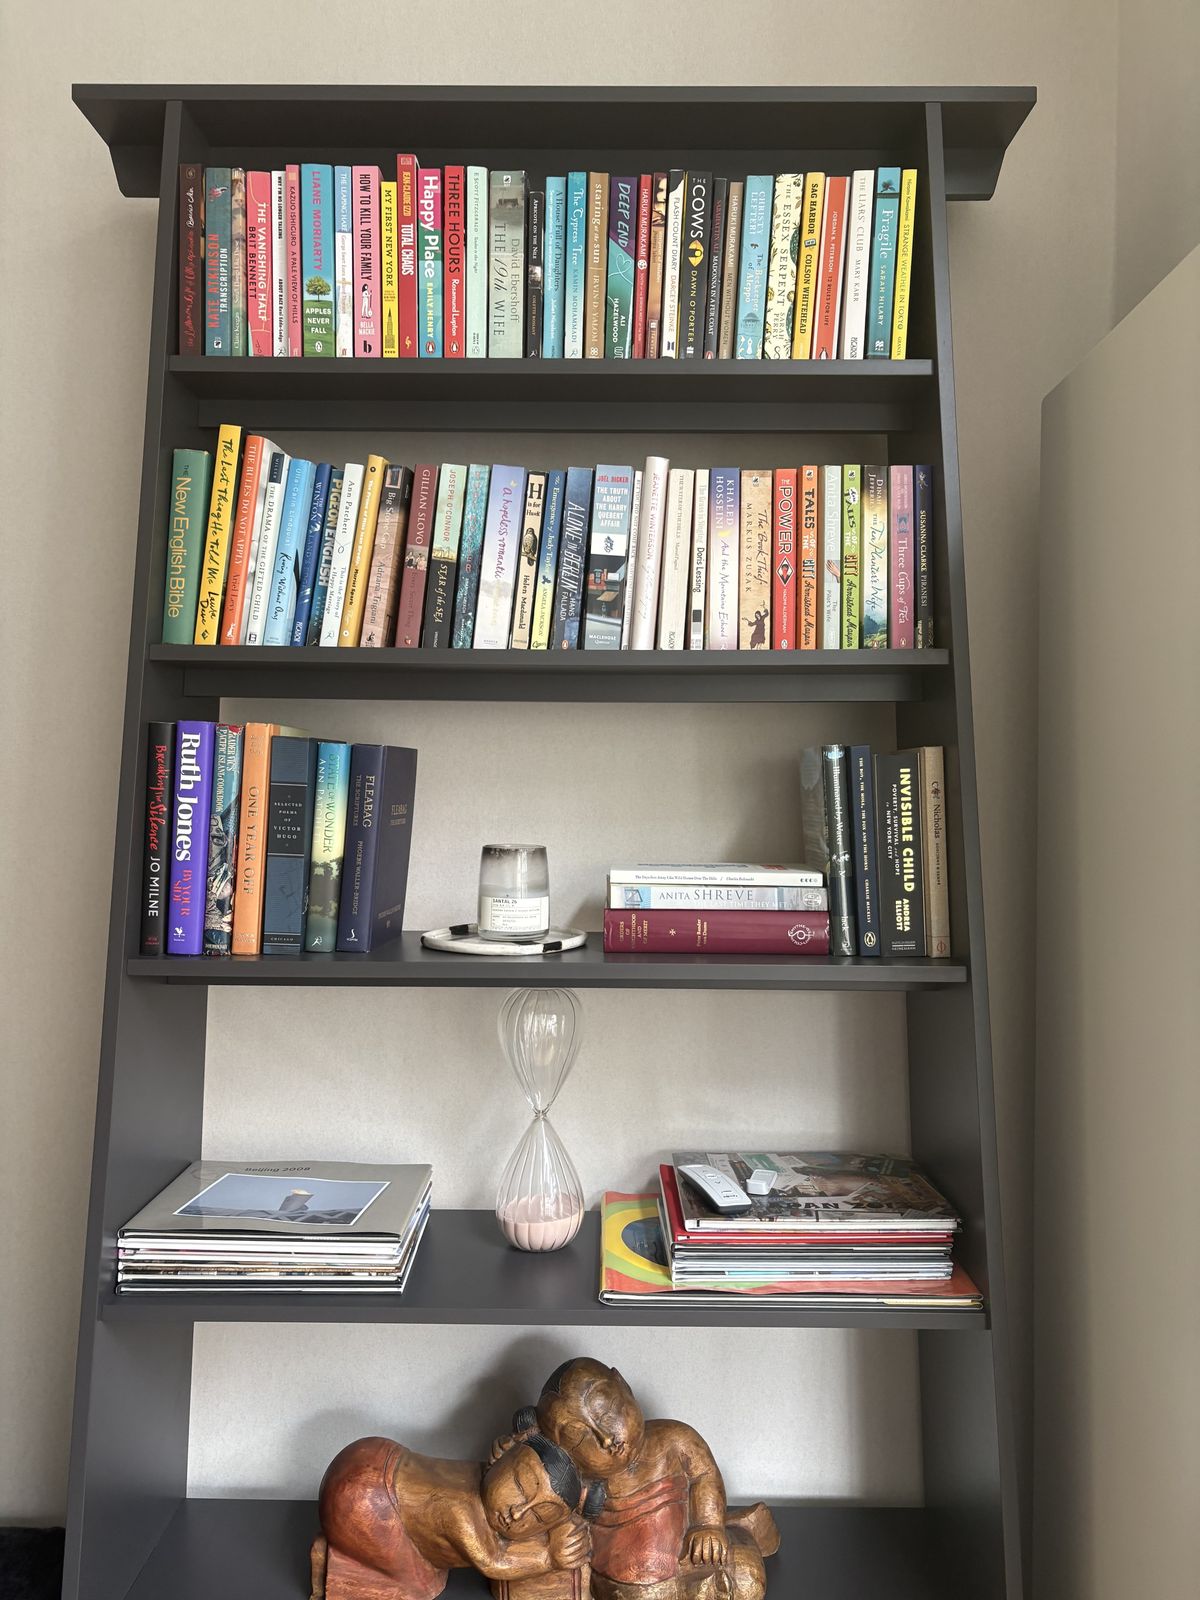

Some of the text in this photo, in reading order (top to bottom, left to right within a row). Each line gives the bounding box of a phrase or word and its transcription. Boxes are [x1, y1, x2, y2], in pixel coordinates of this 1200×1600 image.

[312, 171, 322, 270] LIANE MORIARTY
[385, 190, 392, 204] MY
[618, 183, 630, 247] DEEP END
[691, 184, 705, 238] COWS
[808, 201, 817, 234] HARBOR
[359, 174, 372, 280] HOW TO KILL YOUR FAMILY
[420, 176, 439, 278] Happy Place
[448, 175, 460, 273] THREE HOURS
[572, 188, 583, 265] The Cypress Tree
[878, 209, 893, 258] Fragile
[401, 224, 413, 275] TOTAL CHAOS
[493, 224, 507, 336] THE 19th WIFE
[511, 239, 520, 323] David Ebershoff
[799, 254, 812, 334] COLSON WHITEHEAD
[306, 307, 331, 315] APPLES
[688, 301, 696, 342] O'PORTER
[175, 477, 191, 513] New
[207, 439, 232, 584] The Last Thing He Told Me
[342, 480, 354, 534] Ann Patchett
[415, 469, 430, 544] GILLIAN SLOVO
[443, 469, 456, 541] JOSEPH O'CONNOR
[503, 488, 511, 496] a
[716, 476, 724, 528] HOSSEINI
[726, 480, 734, 525] KHALED
[805, 488, 814, 529] TALES
[827, 473, 837, 552] Anita Shreve
[264, 501, 275, 532] DRAMA
[319, 479, 342, 586] PIGEON ENGLISH
[499, 499, 511, 536] hopeless
[779, 486, 792, 553] POWER
[169, 517, 189, 574] English
[264, 536, 269, 545] OF
[495, 538, 505, 578] romantic
[561, 501, 585, 593] ALONE IN BERLIN
[757, 510, 768, 583] The Book Thief
[898, 538, 907, 568] Three
[256, 562, 266, 592] GIFTED
[694, 547, 704, 592] Doris Lessing
[897, 572, 908, 595] Cups
[169, 578, 184, 618] Bible
[252, 594, 262, 621] CHILD
[519, 597, 527, 629] Macdonald
[899, 606, 908, 623] Tea
[216, 729, 227, 812] PACIFIC ISLAND COOKBOOK
[227, 756, 235, 771] VIC'S
[318, 758, 326, 783] ANN
[176, 732, 201, 861] Ruth Jones
[323, 754, 340, 852] STATE OF WONDER
[362, 776, 374, 828] FLEABAG
[833, 766, 842, 812] Illuminated
[244, 786, 259, 895] ONE YEAR OFF
[834, 813, 842, 821] by
[900, 768, 914, 891] INVISIBLE CHILD
[933, 804, 941, 838] Nicholas
[173, 880, 182, 902] SIDE
[181, 870, 193, 916] BY YOUR
[352, 841, 363, 915] PHOEBE WALLER-BRIDGE
[660, 890, 753, 901] ANITA SHREVE
[895, 900, 903, 931] ELLIOTT
[902, 899, 910, 931] ANDREA
